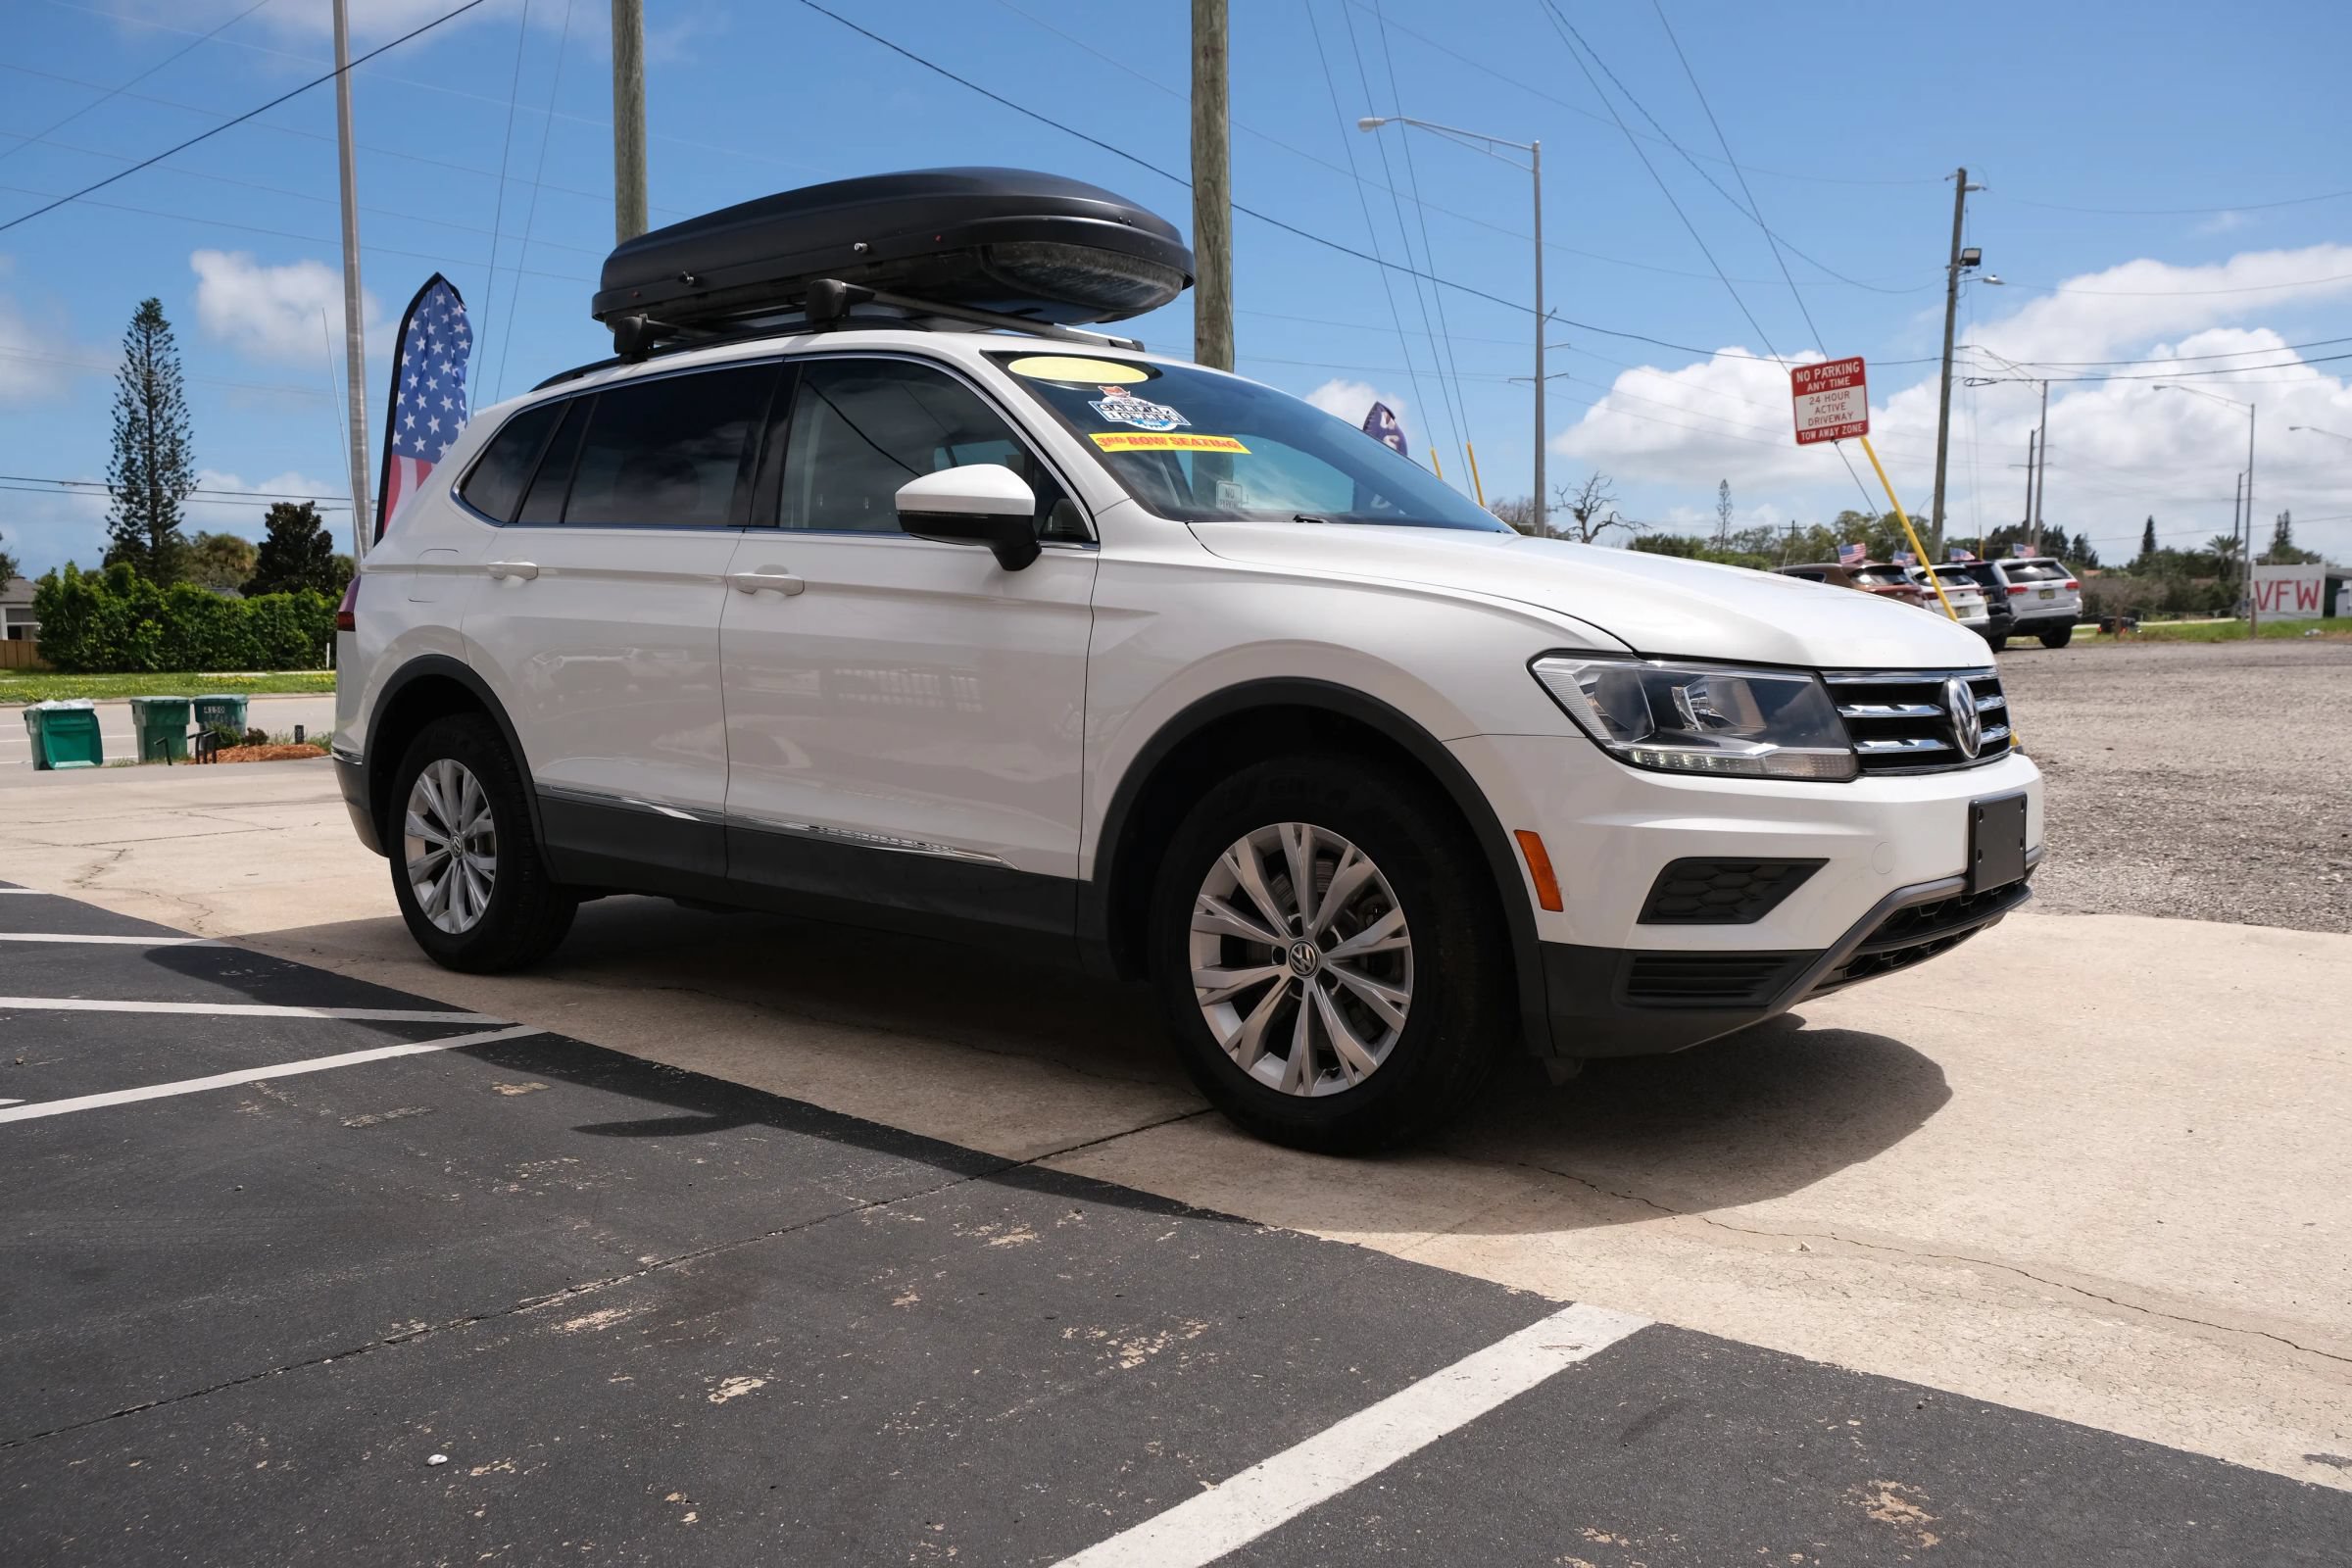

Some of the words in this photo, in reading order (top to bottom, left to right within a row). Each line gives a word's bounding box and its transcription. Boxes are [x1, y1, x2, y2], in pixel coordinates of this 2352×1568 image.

[1796, 370, 1811, 383] NO
[1814, 361, 1860, 380] PARKING
[1807, 379, 1827, 392] ANY
[1829, 376, 1850, 388] TIME
[1809, 396, 1821, 406] 24
[1825, 391, 1850, 403] HOUR
[1815, 402, 1846, 415] ACTIVE
[1808, 412, 1853, 426] DRIVEWAY
[1801, 430, 1817, 440] TOW
[1819, 426, 1839, 438] AWAY
[1842, 422, 1864, 435] ZONE
[1127, 436, 1167, 446] ROW
[1168, 436, 1242, 449] SEATING
[2254, 579, 2321, 612] VFW
